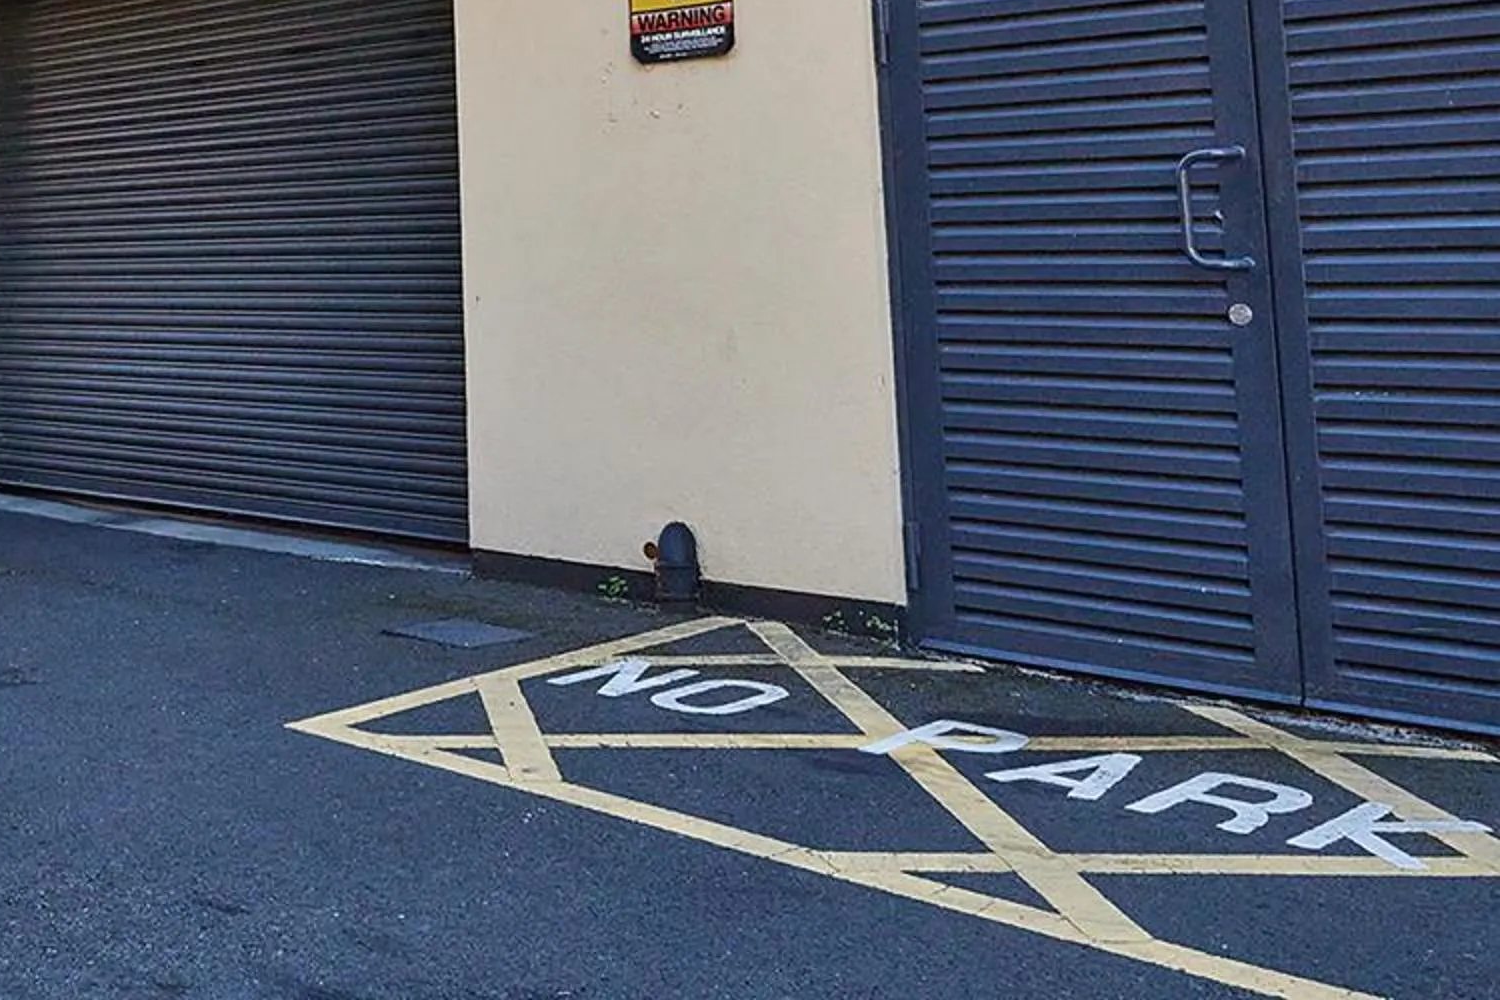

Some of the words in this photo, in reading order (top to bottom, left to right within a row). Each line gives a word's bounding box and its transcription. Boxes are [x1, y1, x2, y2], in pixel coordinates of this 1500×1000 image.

[637, 5, 725, 31] WARNING
[547, 655, 790, 715] NO
[857, 719, 1495, 870] PARK
